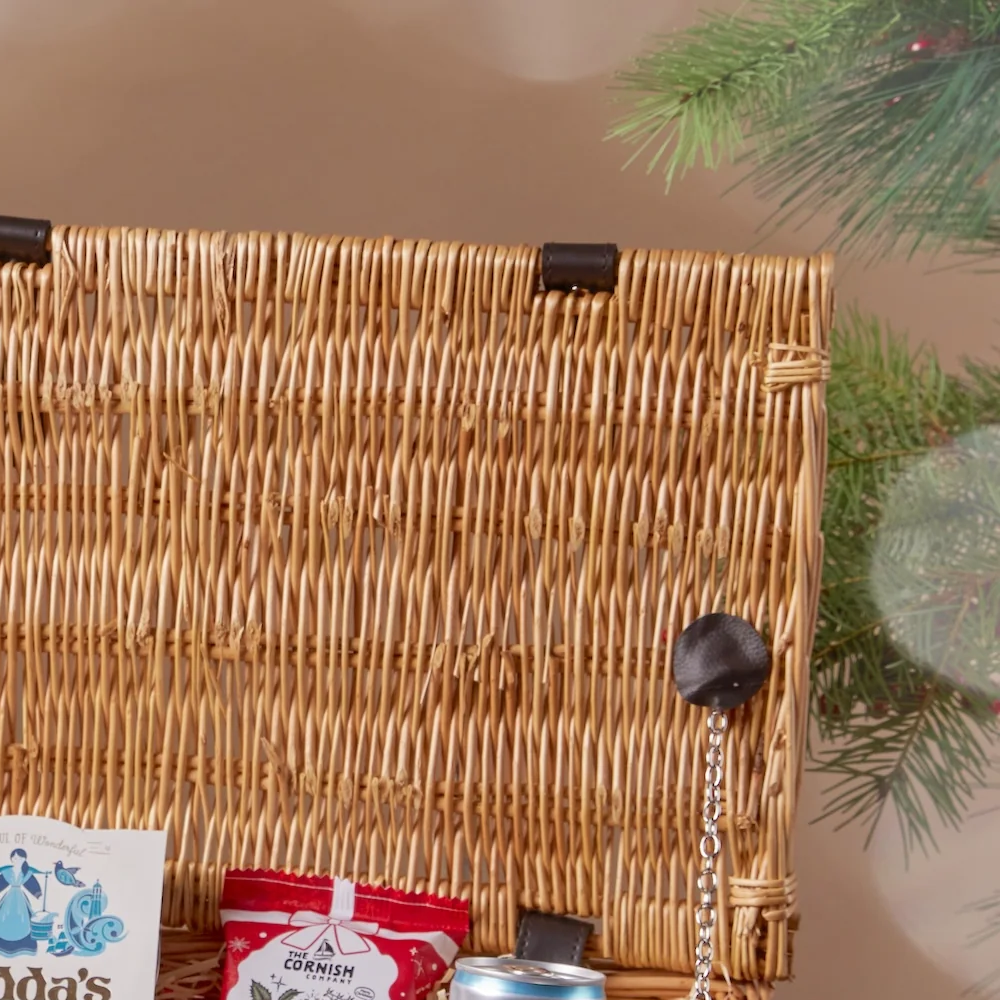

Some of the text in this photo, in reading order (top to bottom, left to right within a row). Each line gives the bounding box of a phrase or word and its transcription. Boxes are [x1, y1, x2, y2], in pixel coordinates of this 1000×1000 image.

[14, 833, 28, 844] OF
[30, 834, 88, 857] Wonderful
[288, 950, 309, 960] THE
[283, 958, 355, 978] CORNISH
[306, 973, 353, 985] COMPANY
